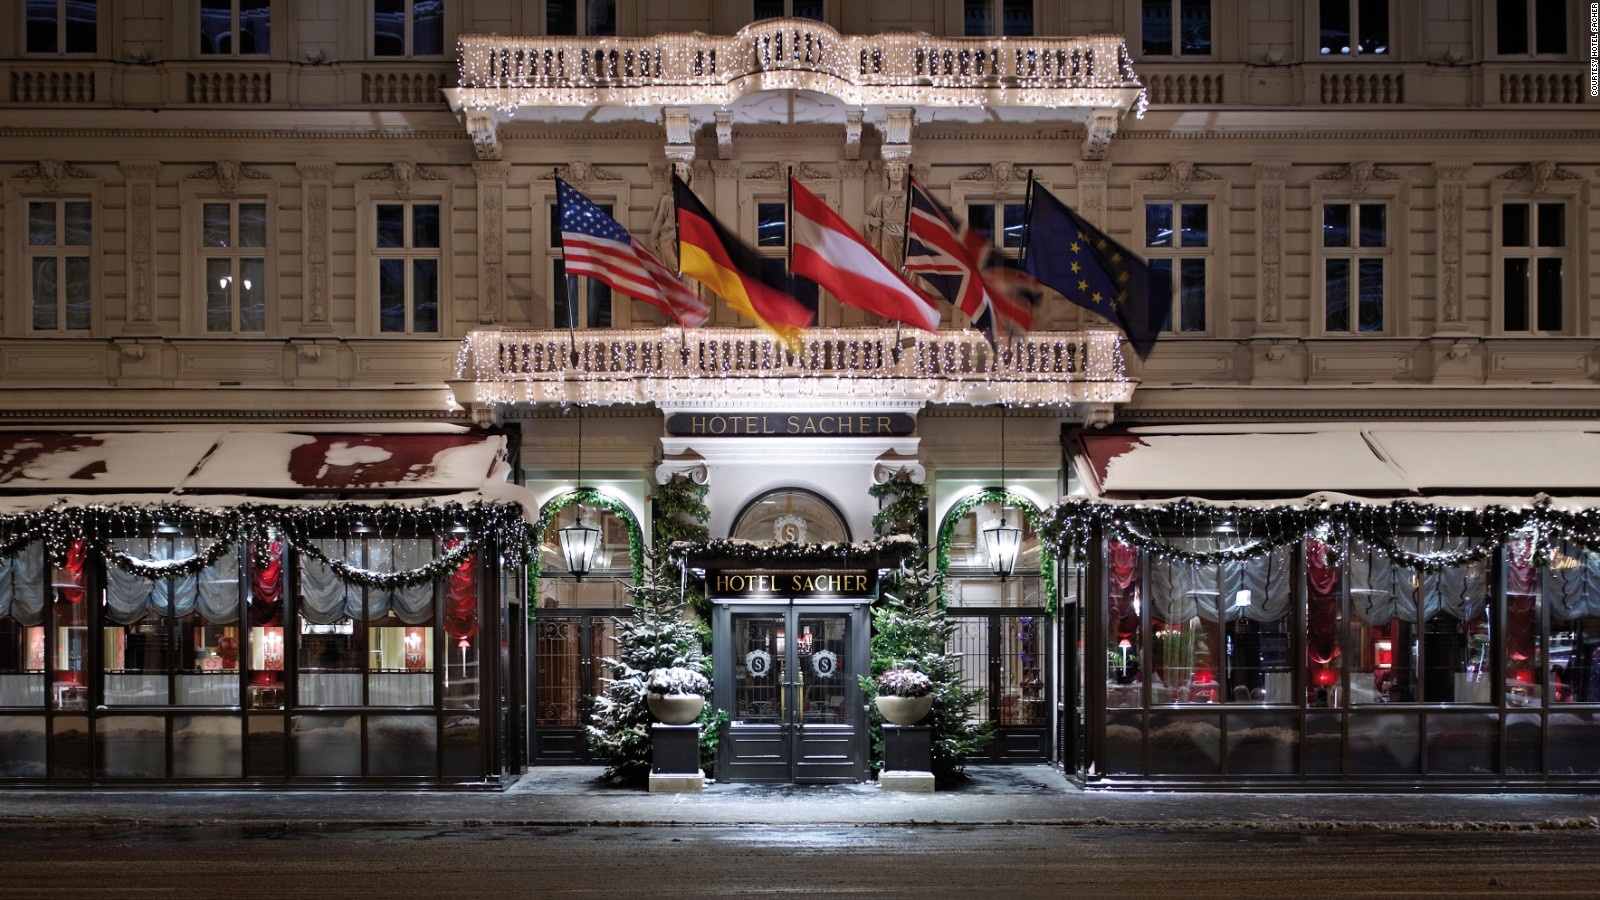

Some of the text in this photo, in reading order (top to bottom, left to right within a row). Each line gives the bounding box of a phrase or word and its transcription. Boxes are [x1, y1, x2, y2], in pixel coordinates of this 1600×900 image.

[692, 415, 892, 434] HOTEL SACHER
[786, 527, 795, 541] S
[716, 575, 868, 592] HOTEL SACHER
[754, 658, 762, 671] S
[821, 658, 829, 671] S
